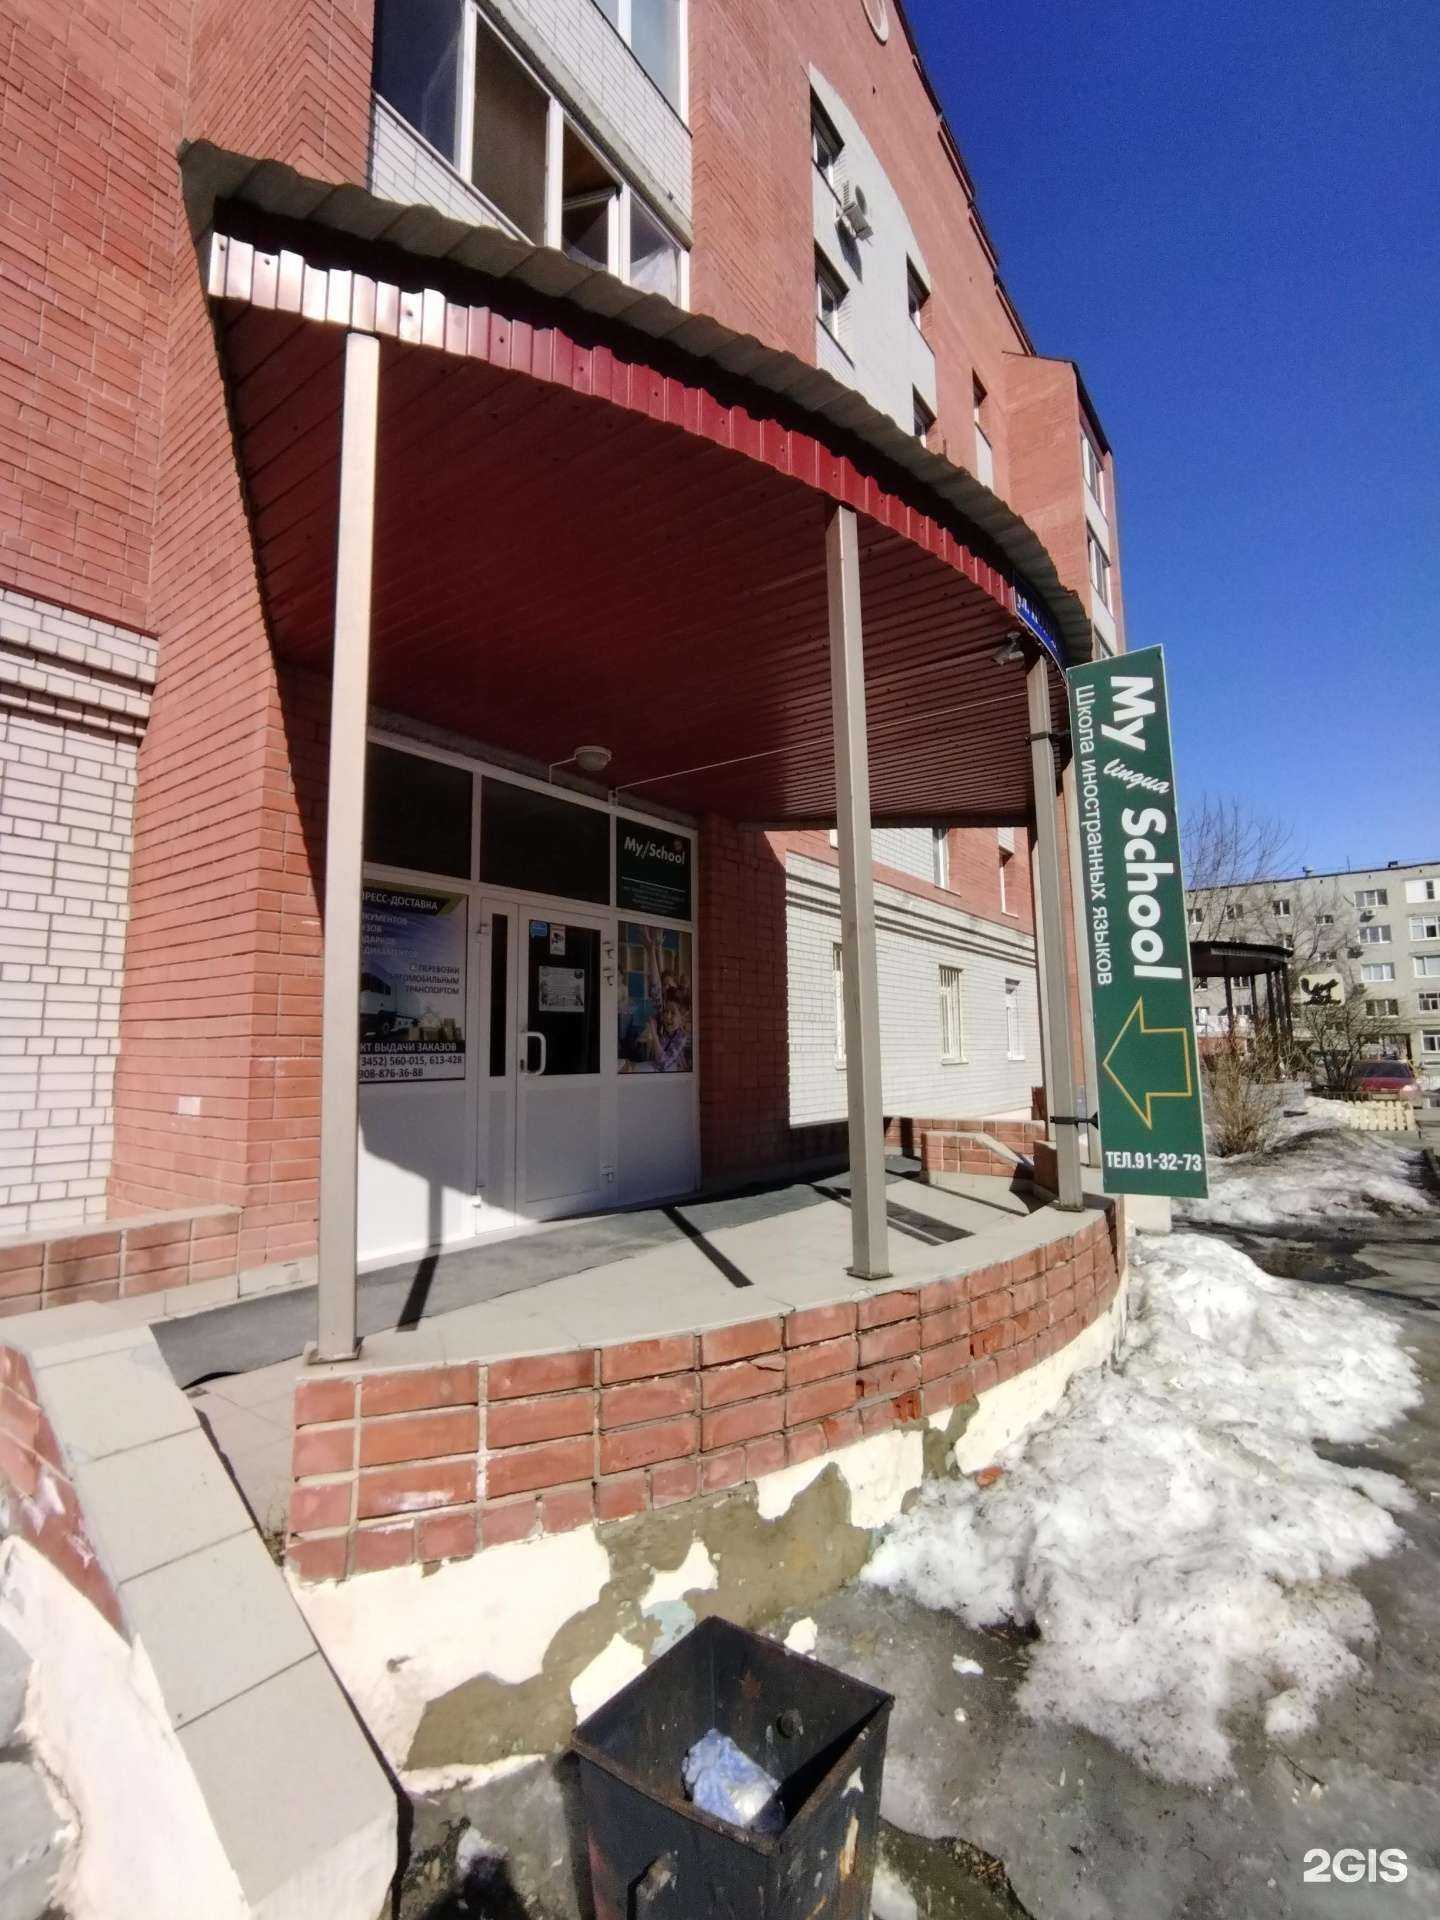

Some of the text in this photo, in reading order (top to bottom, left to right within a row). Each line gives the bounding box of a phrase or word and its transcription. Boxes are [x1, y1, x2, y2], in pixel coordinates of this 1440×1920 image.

[1075, 684, 1112, 985] Школа иностранных языков
[1101, 676, 1184, 979] My lingua School
[375, 1042, 415, 1053] ВЫДАЧИ
[417, 1042, 457, 1052] ЗАКАЗОВ
[1104, 1151, 1202, 1171] ТЕЛ.91-32-73
